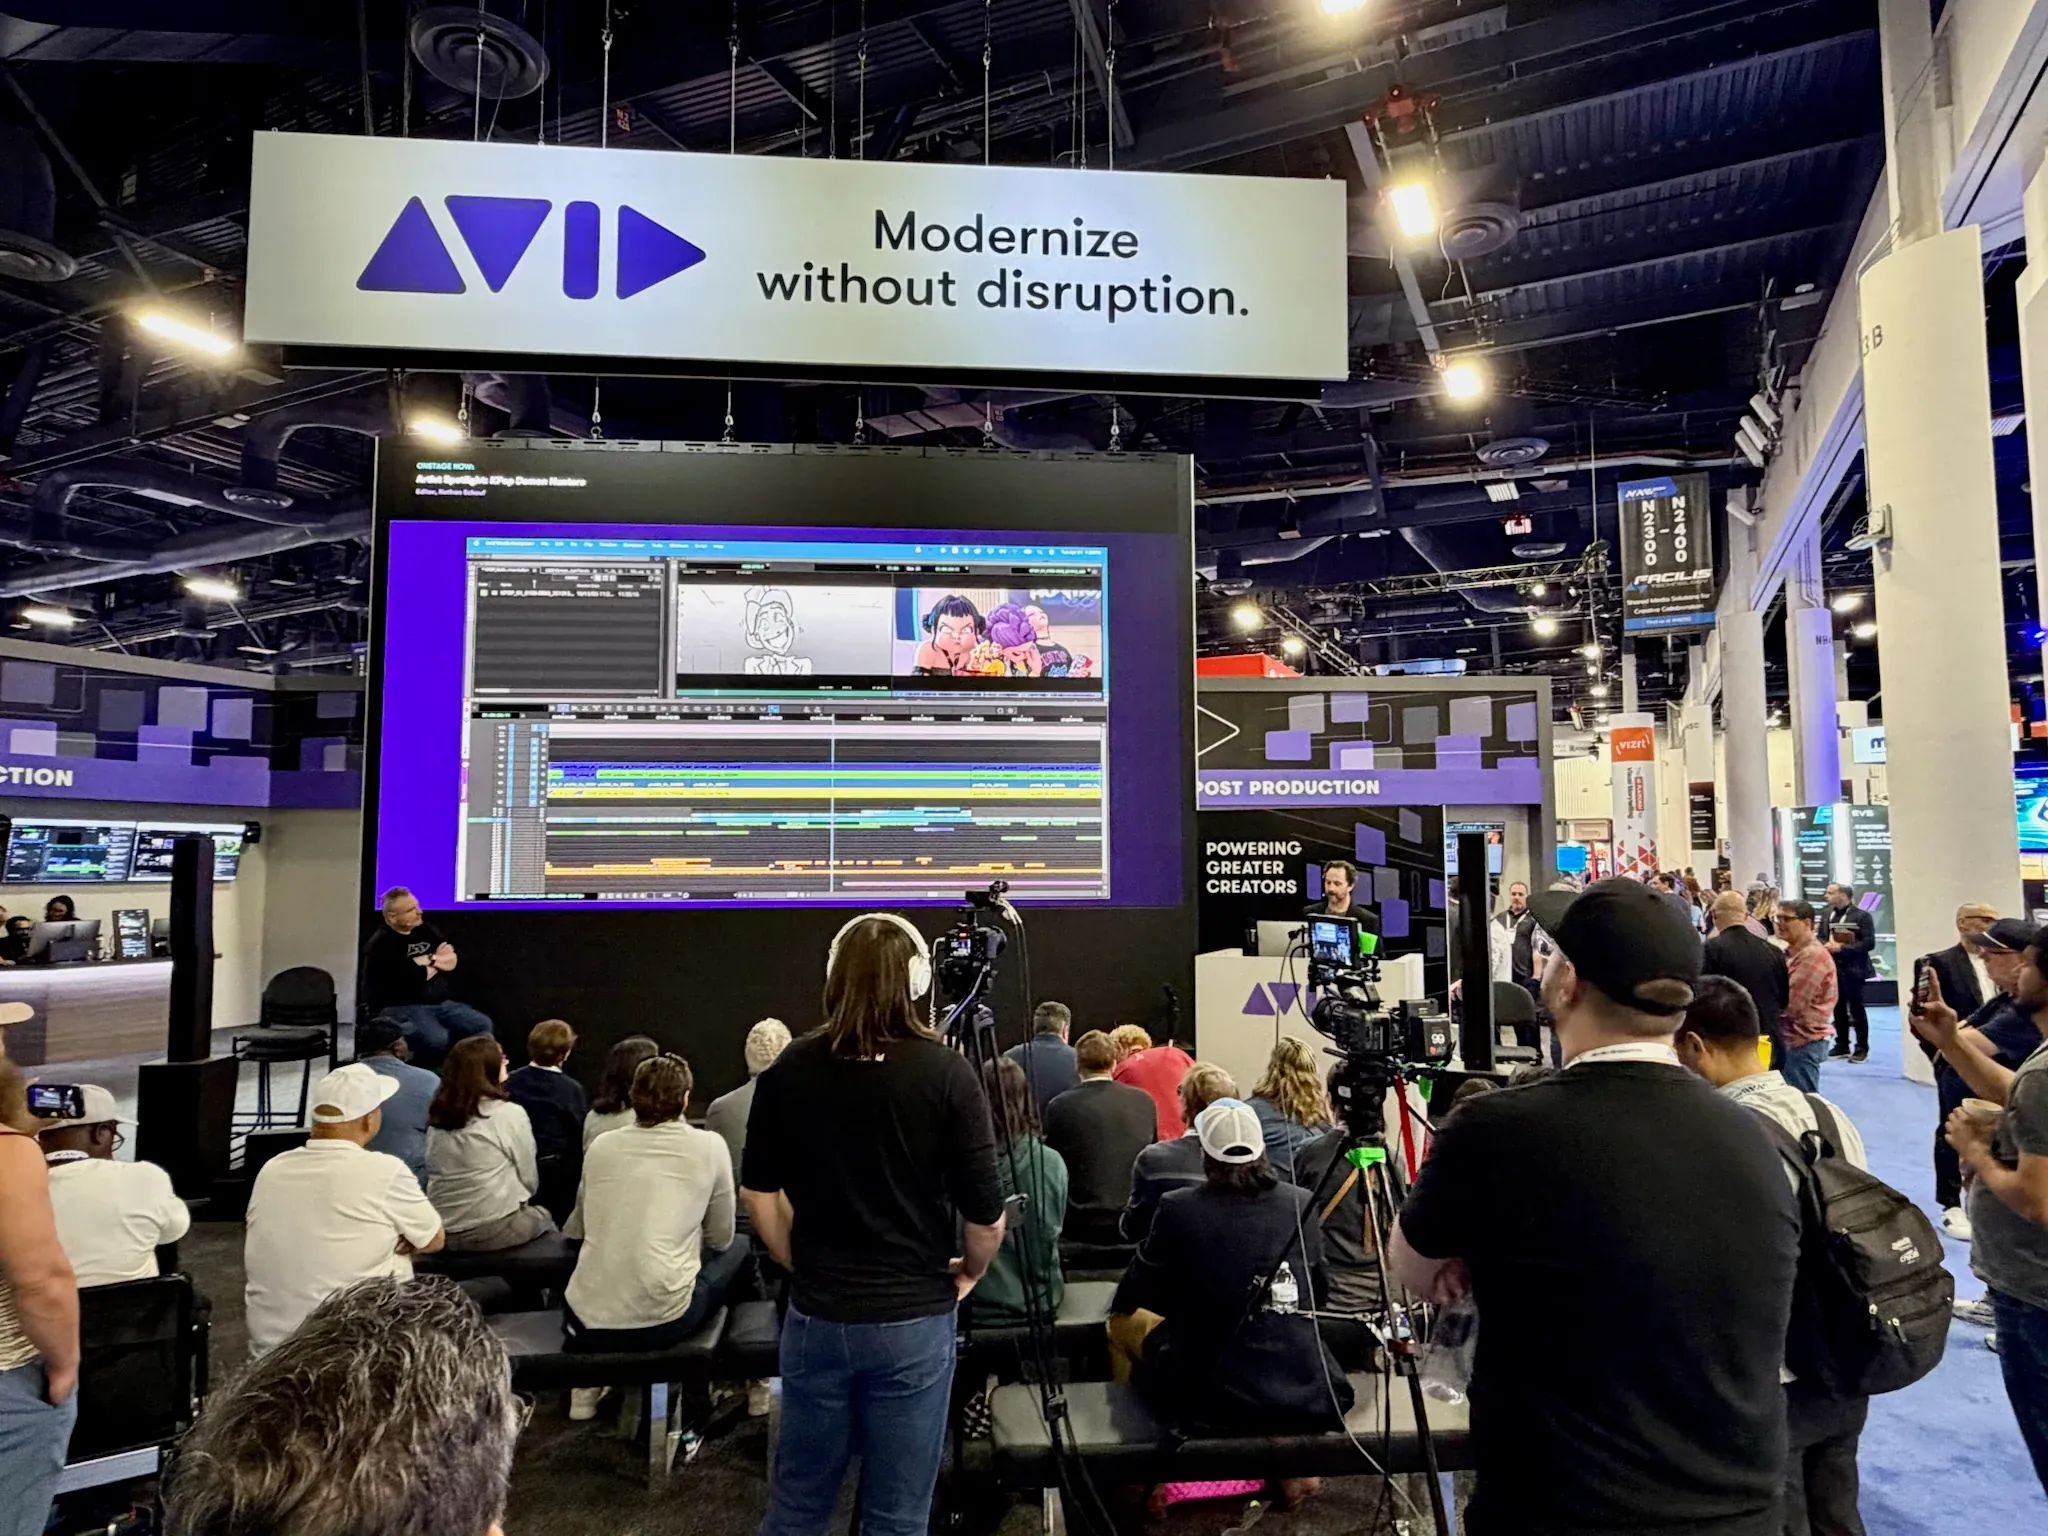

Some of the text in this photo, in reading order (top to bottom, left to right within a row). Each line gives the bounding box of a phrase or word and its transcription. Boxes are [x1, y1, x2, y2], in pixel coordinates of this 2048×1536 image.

[873, 209, 1139, 258] Modernize
[356, 195, 706, 300] AVID
[756, 261, 1249, 323] without disruption.
[1641, 499, 1657, 566] N2300
[1672, 495, 1688, 563] N2400
[1633, 568, 1713, 585] FACILIS
[1249, 780, 1380, 796] PRODUCTION
[1206, 841, 1302, 856] POWERING
[1206, 860, 1284, 875] GREATER
[1206, 879, 1298, 894] CREATORS
